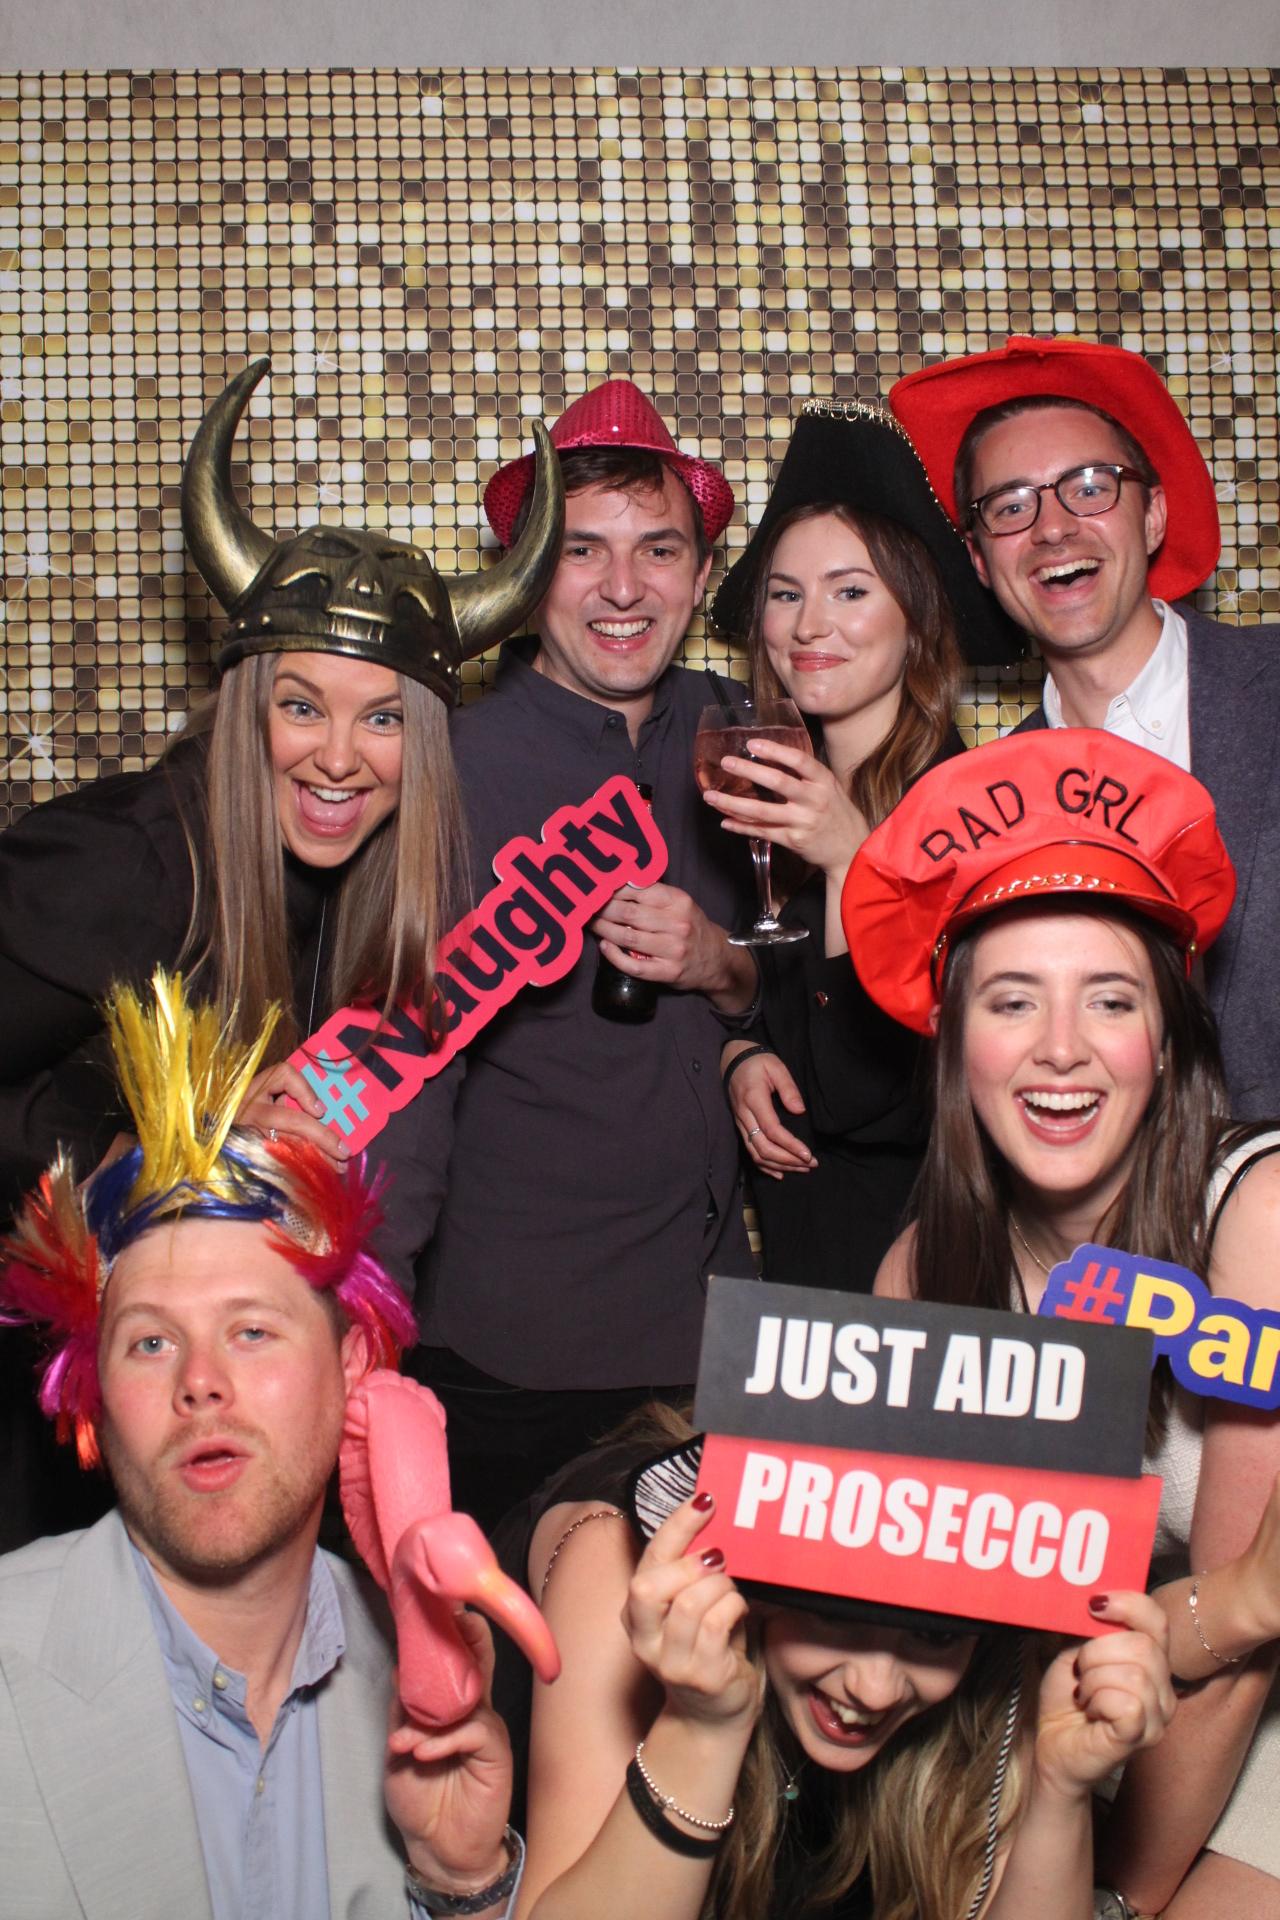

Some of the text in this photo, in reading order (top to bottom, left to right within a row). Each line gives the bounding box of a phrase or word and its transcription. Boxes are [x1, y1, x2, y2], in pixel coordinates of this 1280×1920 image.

[301, 791, 652, 1136] #Naughty
[744, 1316, 1086, 1421] JUST ADD
[733, 1452, 1110, 1586] PROSECCO
